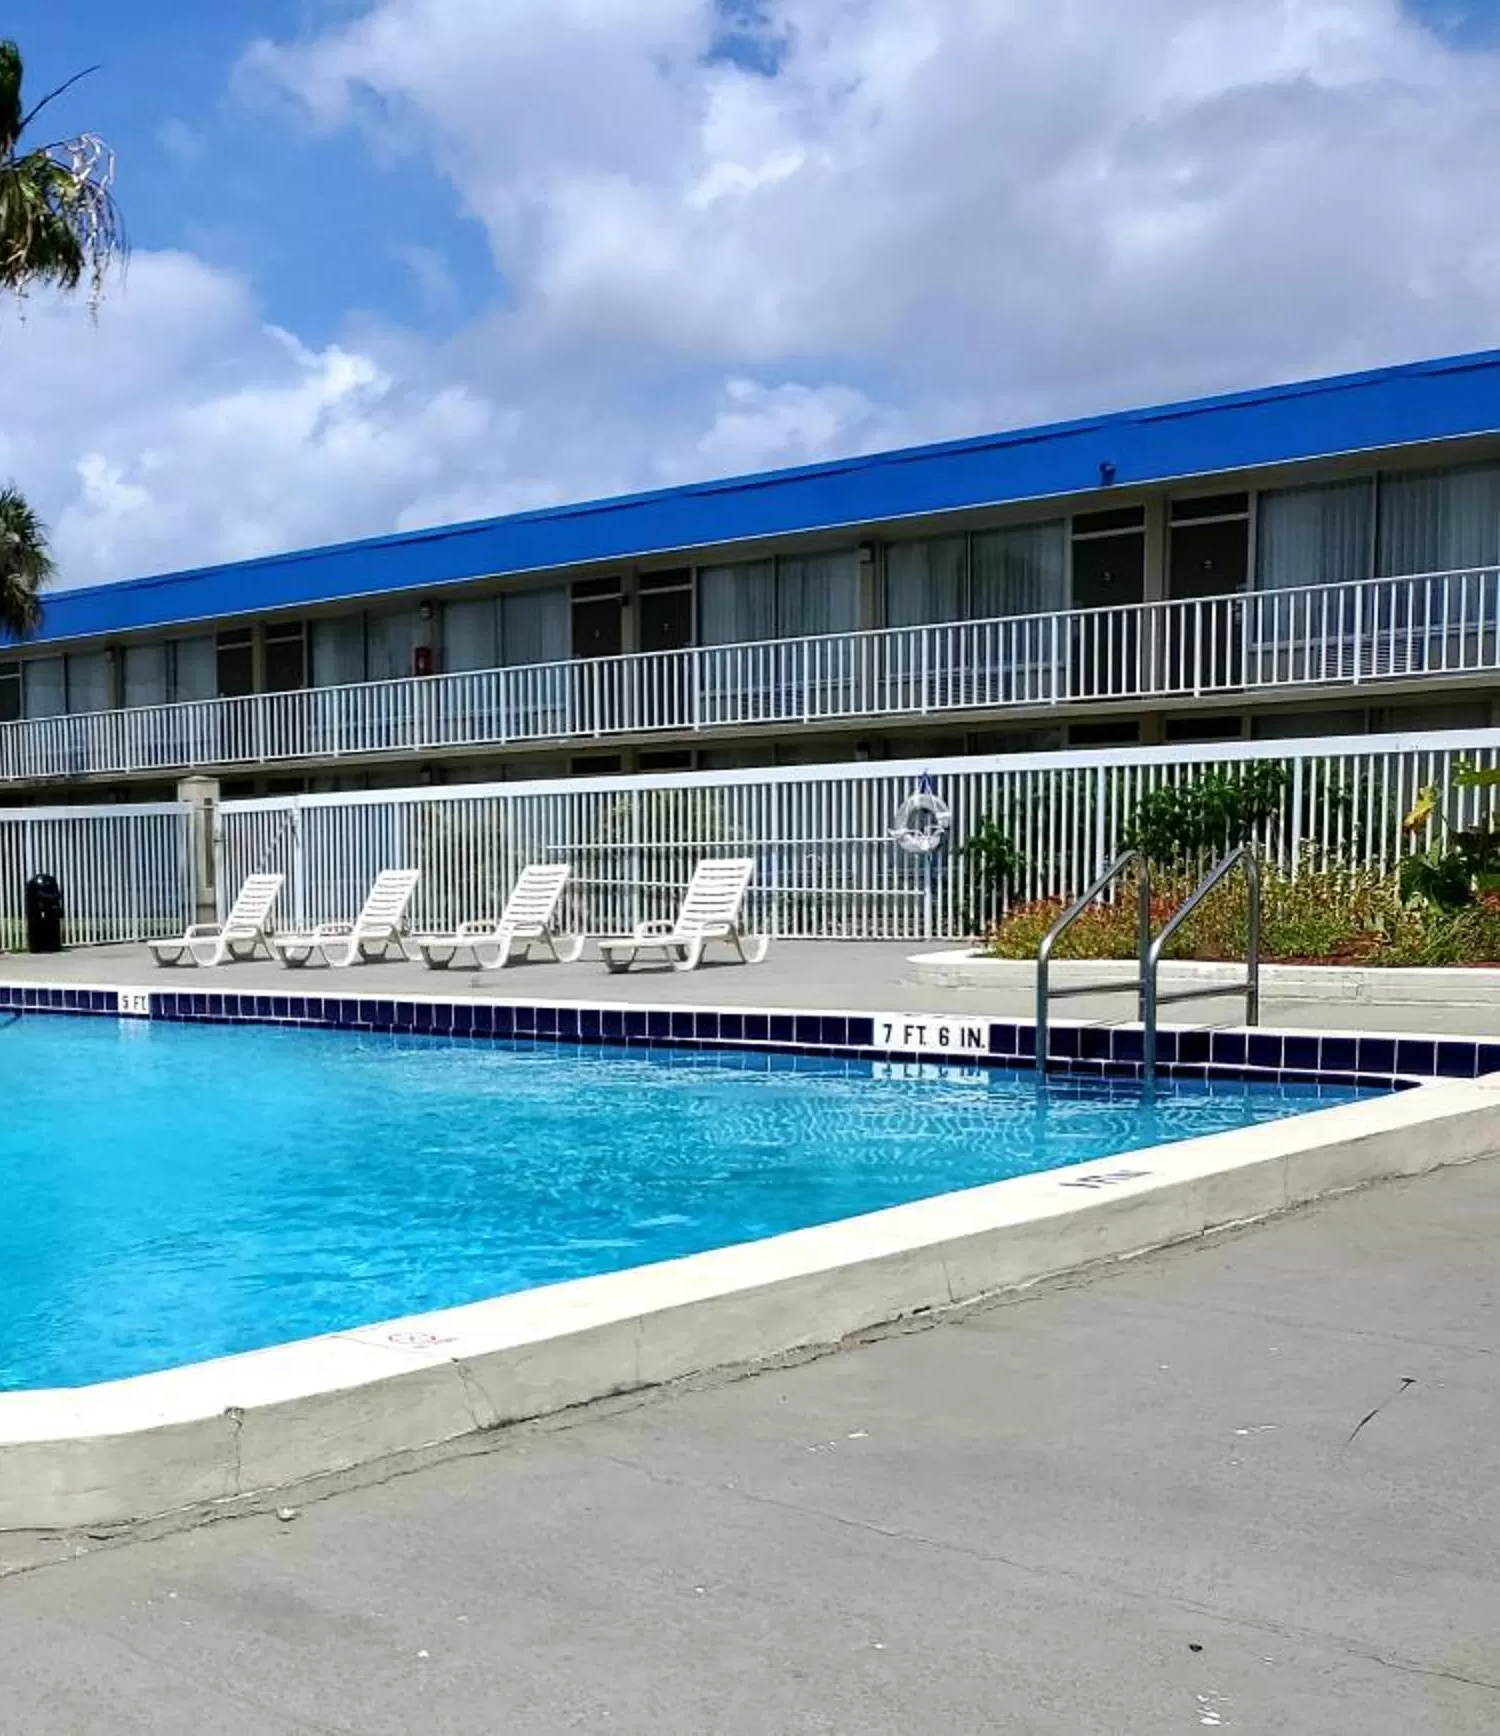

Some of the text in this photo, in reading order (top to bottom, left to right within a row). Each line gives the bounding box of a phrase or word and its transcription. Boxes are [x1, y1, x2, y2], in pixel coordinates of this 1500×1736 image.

[883, 1023, 986, 1049] 7 FT. 6 IN.
